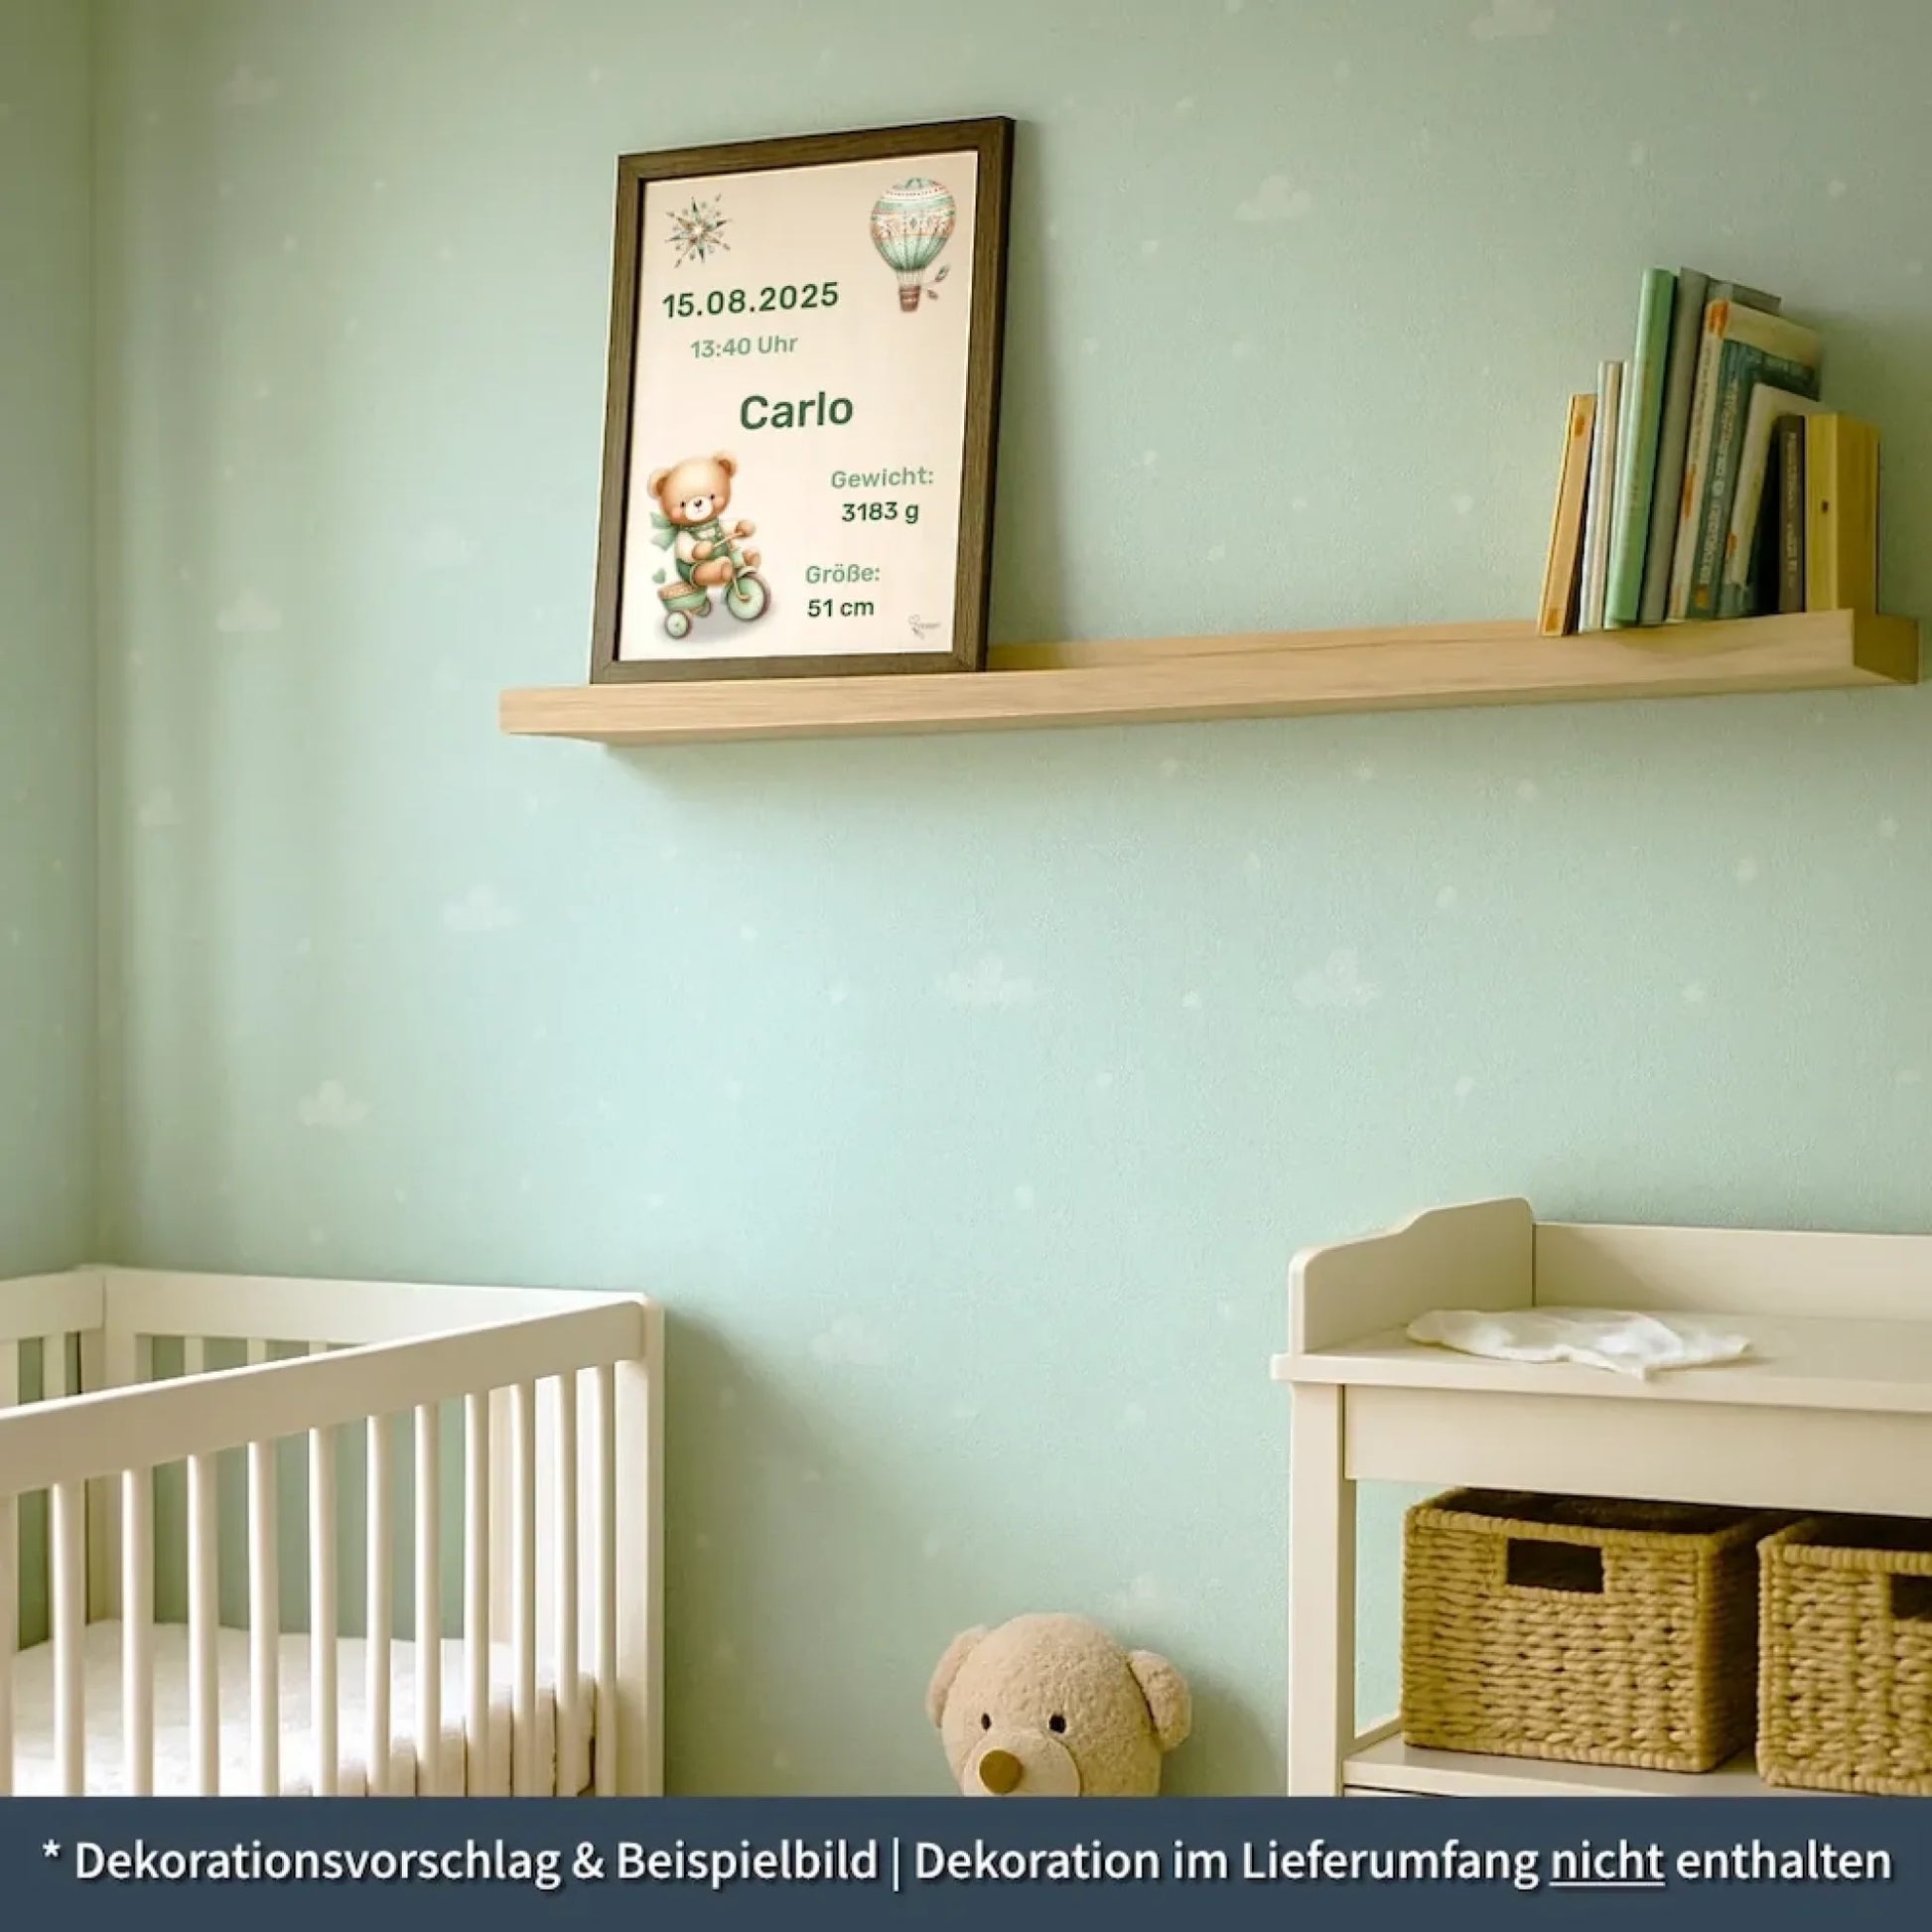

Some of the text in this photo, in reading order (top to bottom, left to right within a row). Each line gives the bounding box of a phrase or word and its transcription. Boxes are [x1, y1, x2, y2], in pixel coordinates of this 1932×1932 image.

[661, 281, 840, 320] 15.08.2025
[690, 335, 799, 359] 13:40 Uhr
[739, 390, 855, 430] Carlo
[830, 466, 934, 490] Gewicht:
[841, 500, 920, 525] 3183 g
[804, 563, 881, 585] Größe:
[806, 598, 875, 620] 51 cm
